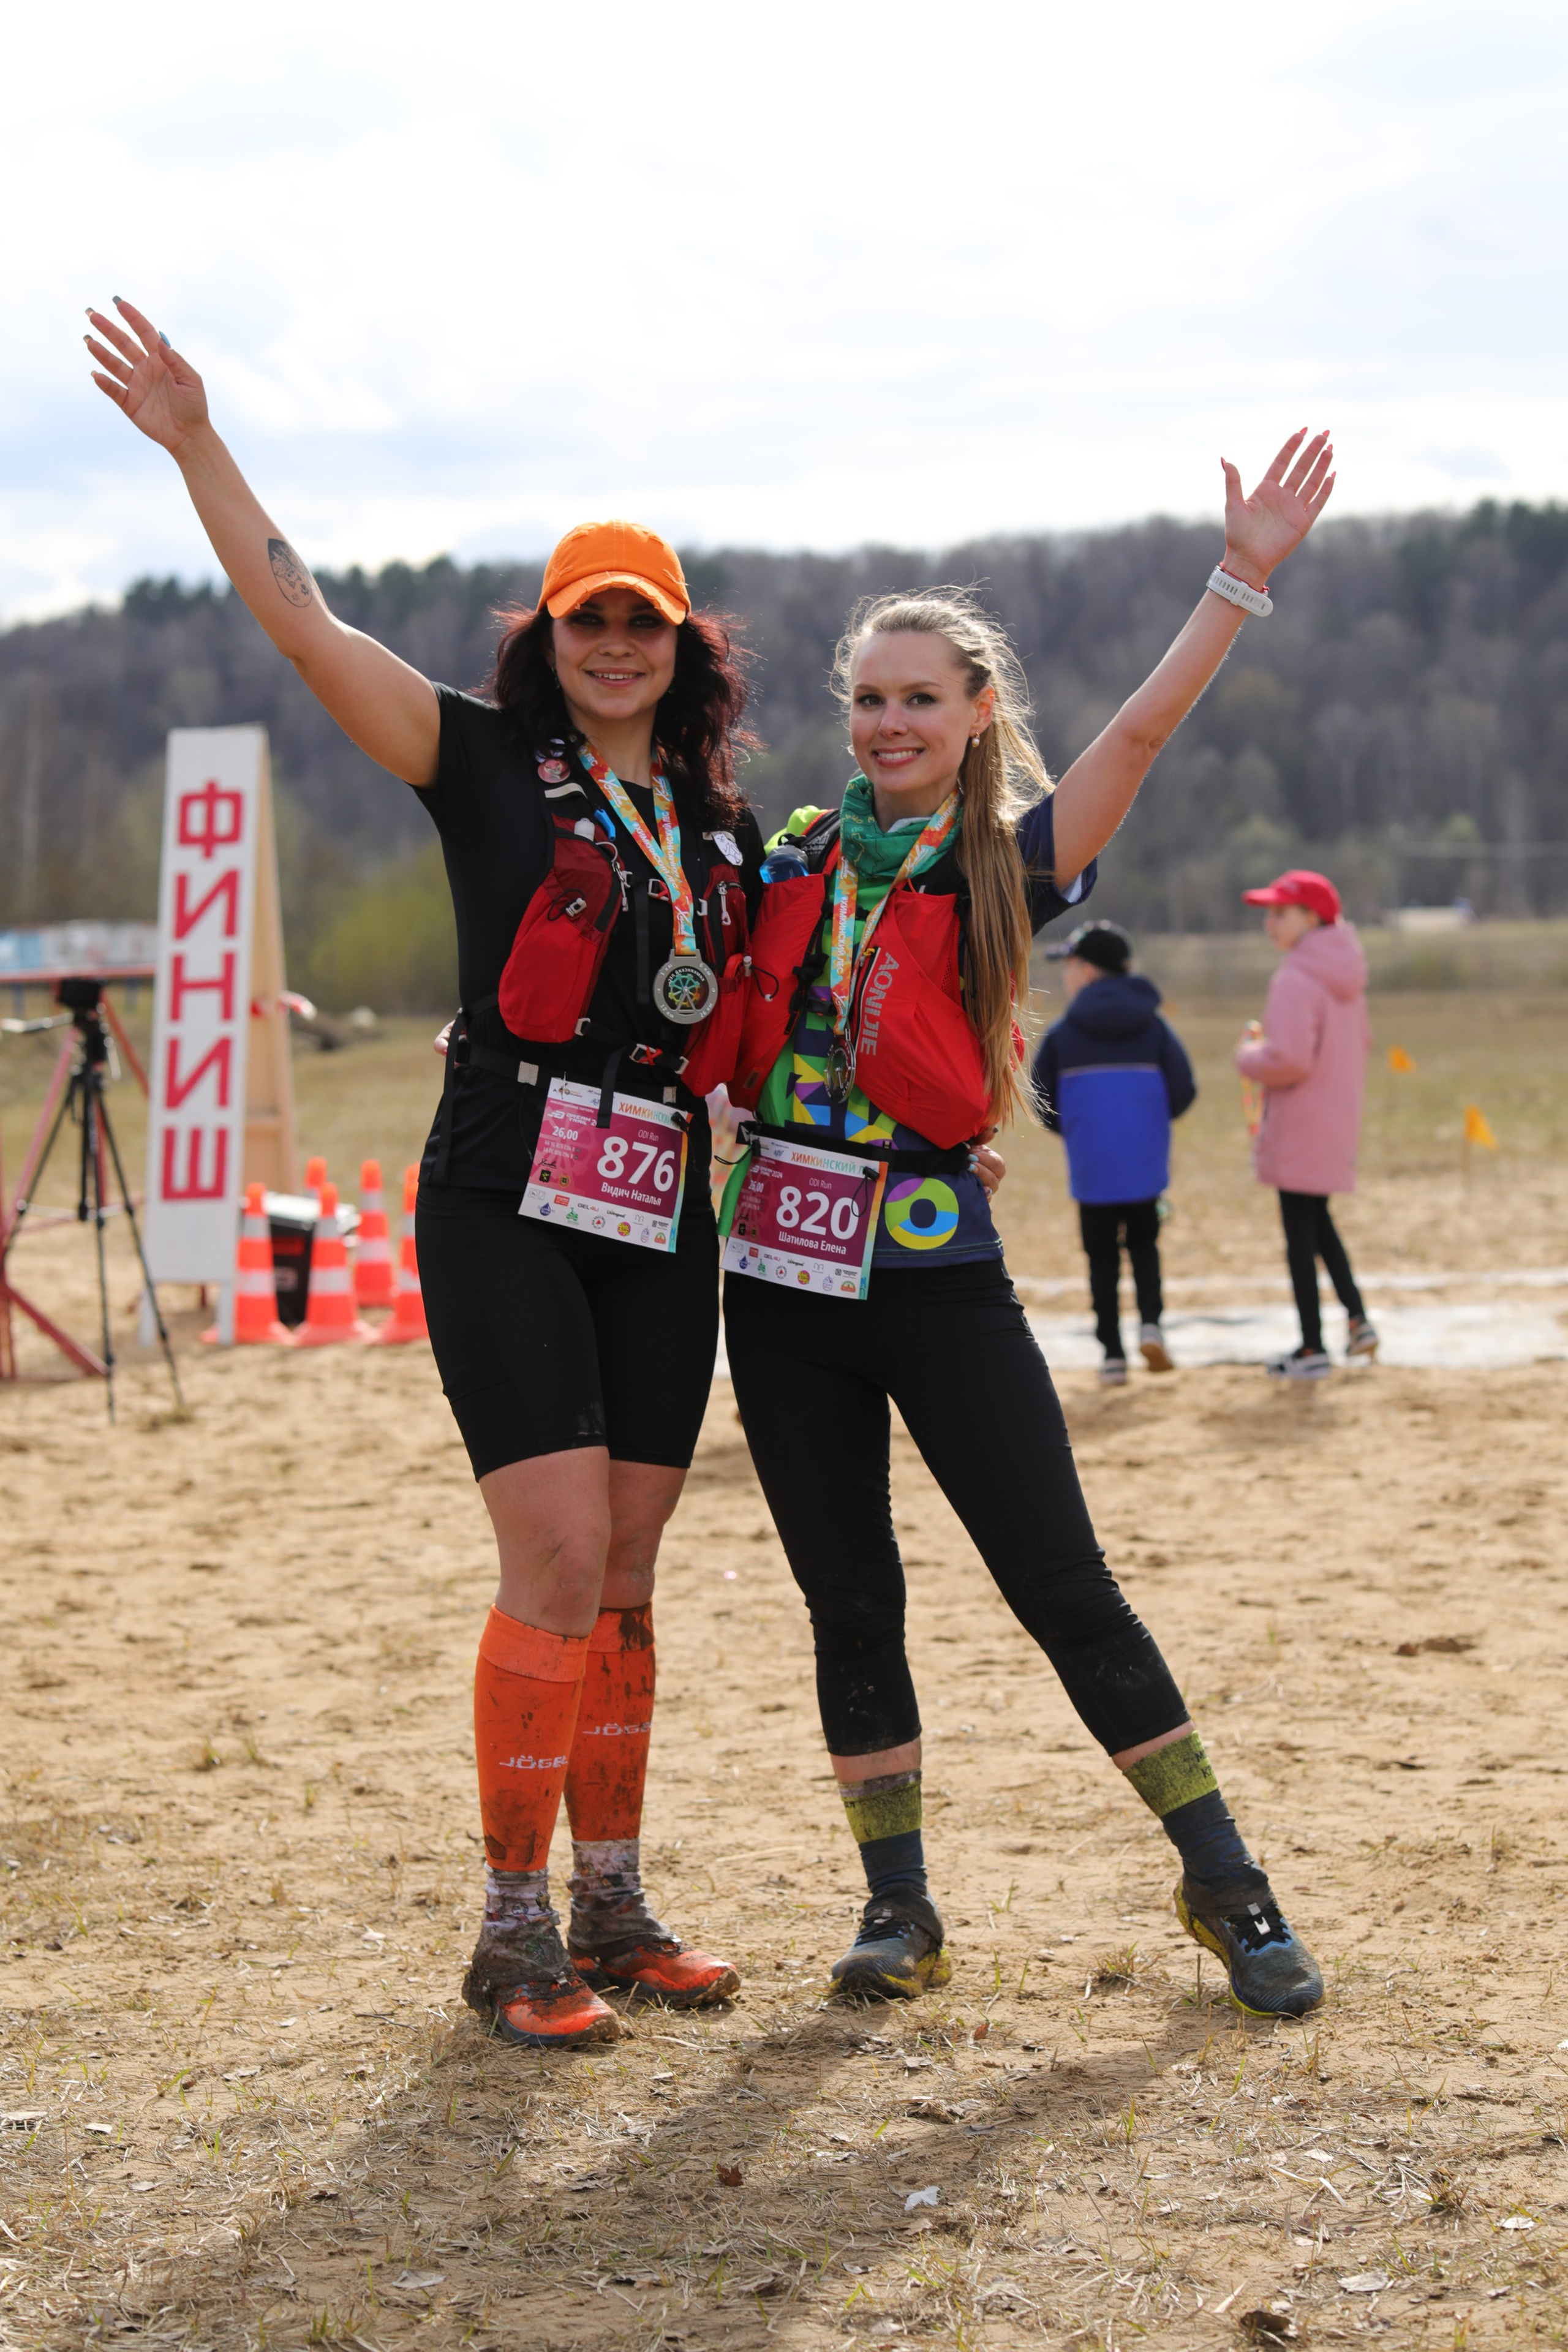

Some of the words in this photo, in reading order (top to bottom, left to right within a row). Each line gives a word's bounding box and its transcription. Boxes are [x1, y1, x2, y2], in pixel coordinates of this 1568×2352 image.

[836, 955, 845, 974] ЛЕС
[162, 779, 245, 1200] ФИНИШ
[860, 951, 899, 1056] AONIJE
[566, 1112, 591, 1122] DREAM
[552, 1126, 578, 1141] 26,00
[638, 1129, 649, 1139] ODI
[649, 1132, 659, 1142] Run
[597, 1136, 676, 1193] 876
[791, 1152, 856, 1174] ХИМКИНСКИЙ
[772, 1170, 783, 1179] 2024
[809, 1178, 820, 1187] ODI
[821, 1180, 832, 1189] Run
[601, 1182, 630, 1199] Видич
[630, 1189, 662, 1207] Наталья
[748, 1180, 764, 1193] 26,00
[776, 1185, 859, 1240] 820
[778, 1231, 819, 1250] Шатилова
[820, 1240, 847, 1255] Елена
